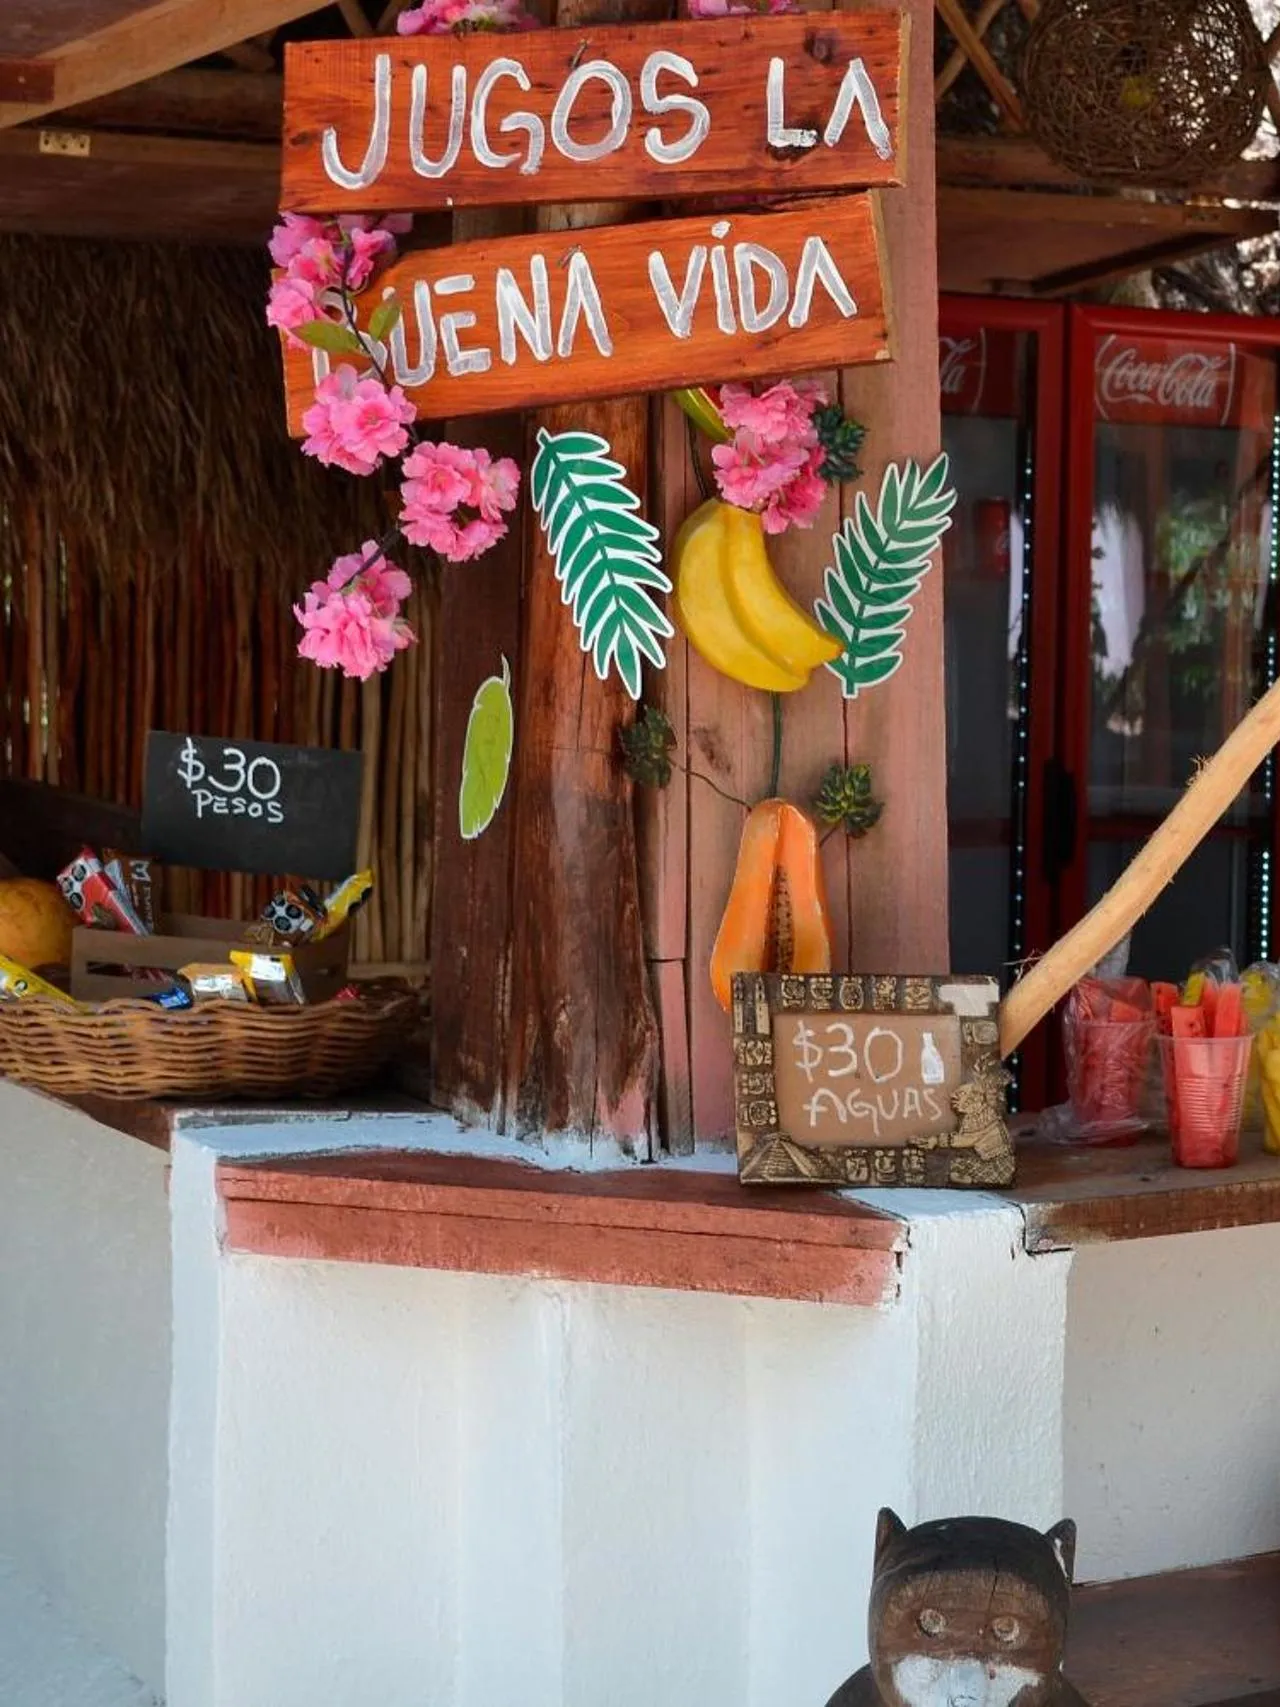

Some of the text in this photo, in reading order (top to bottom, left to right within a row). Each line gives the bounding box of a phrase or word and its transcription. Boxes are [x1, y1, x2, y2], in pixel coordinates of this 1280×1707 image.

[321, 50, 893, 190] JUGOS LA
[1101, 348, 1228, 408] Coca-Cola
[177, 736, 282, 800] $30
[191, 788, 284, 824] PESOS
[791, 1019, 904, 1084] $30
[802, 1087, 943, 1137] AGUAS
